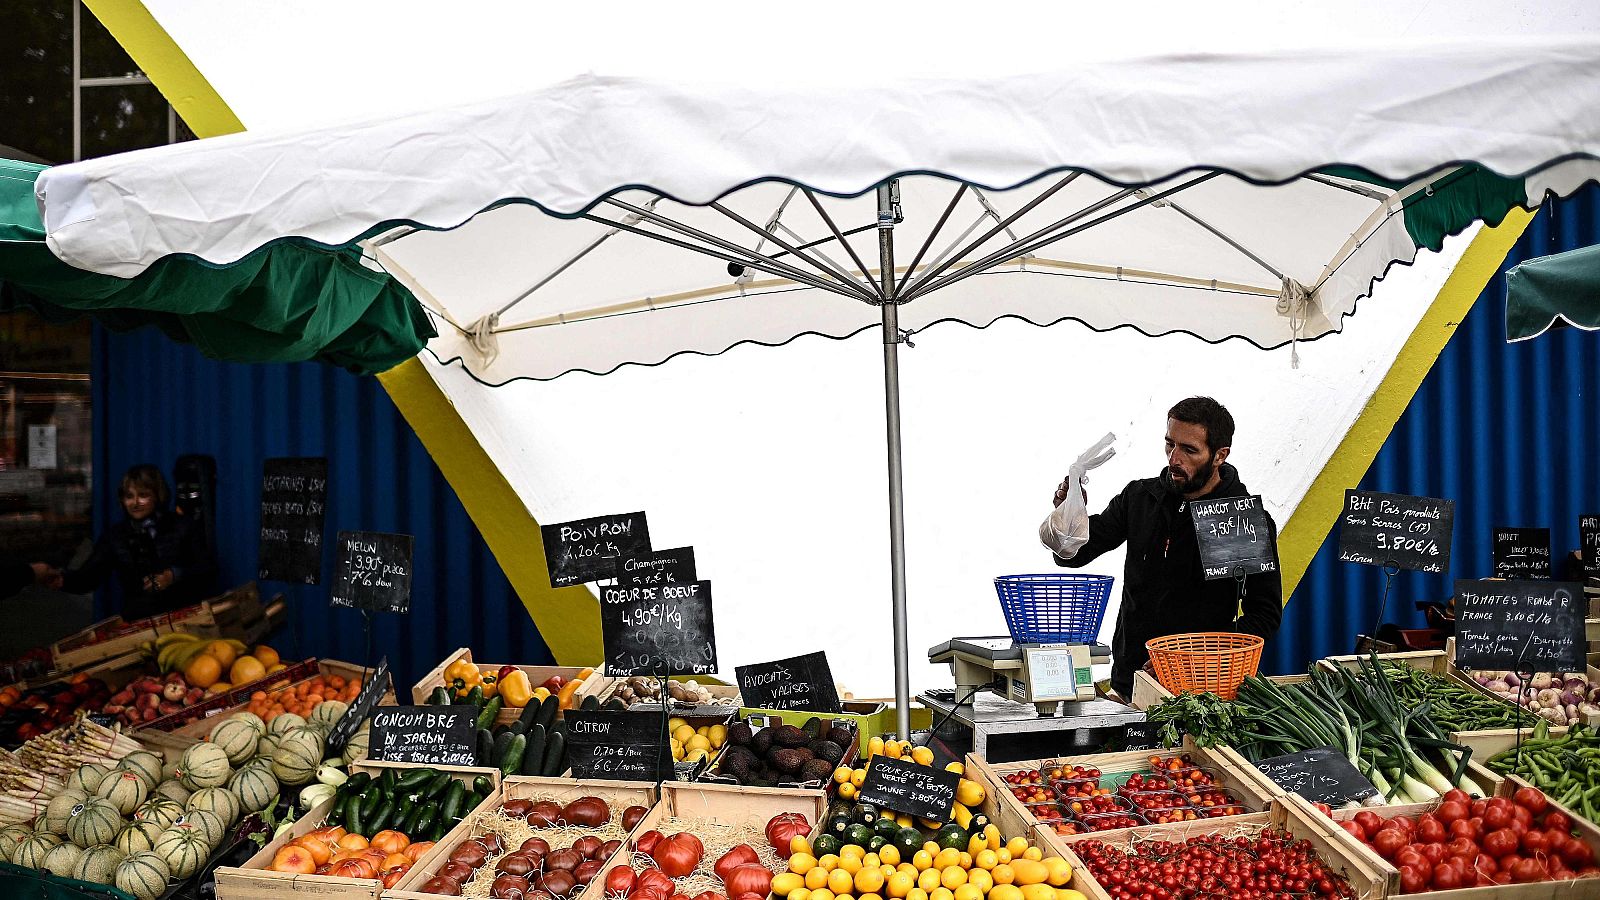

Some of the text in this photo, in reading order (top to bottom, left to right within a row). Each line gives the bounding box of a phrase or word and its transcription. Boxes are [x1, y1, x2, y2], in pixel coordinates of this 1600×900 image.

[1196, 497, 1256, 518] HARICOT VERT
[1350, 496, 1374, 510] Petit
[1380, 500, 1400, 514] Pois
[1346, 515, 1430, 535] Sous Serres (17)
[348, 540, 376, 554] MELON
[565, 542, 620, 559] 4,20€ Kg
[355, 555, 382, 570] 3,90€
[624, 558, 678, 571] Champignon
[1206, 567, 1228, 577] FRANCE
[606, 584, 700, 603] COEUR DE BOEUF
[1462, 592, 1518, 606] TOMATES
[1561, 598, 1568, 607] R
[1462, 610, 1493, 620] FRANCE
[1461, 630, 1489, 640] Tomate
[608, 665, 633, 676] France
[693, 665, 708, 674] CAT
[744, 669, 792, 688] AVOCATS
[374, 713, 457, 728] CONCOMBRE
[875, 764, 934, 782] COURGETTE
[882, 774, 907, 784] VERTE
[877, 784, 906, 796] JAUNE
[860, 795, 887, 806] FRANCE
